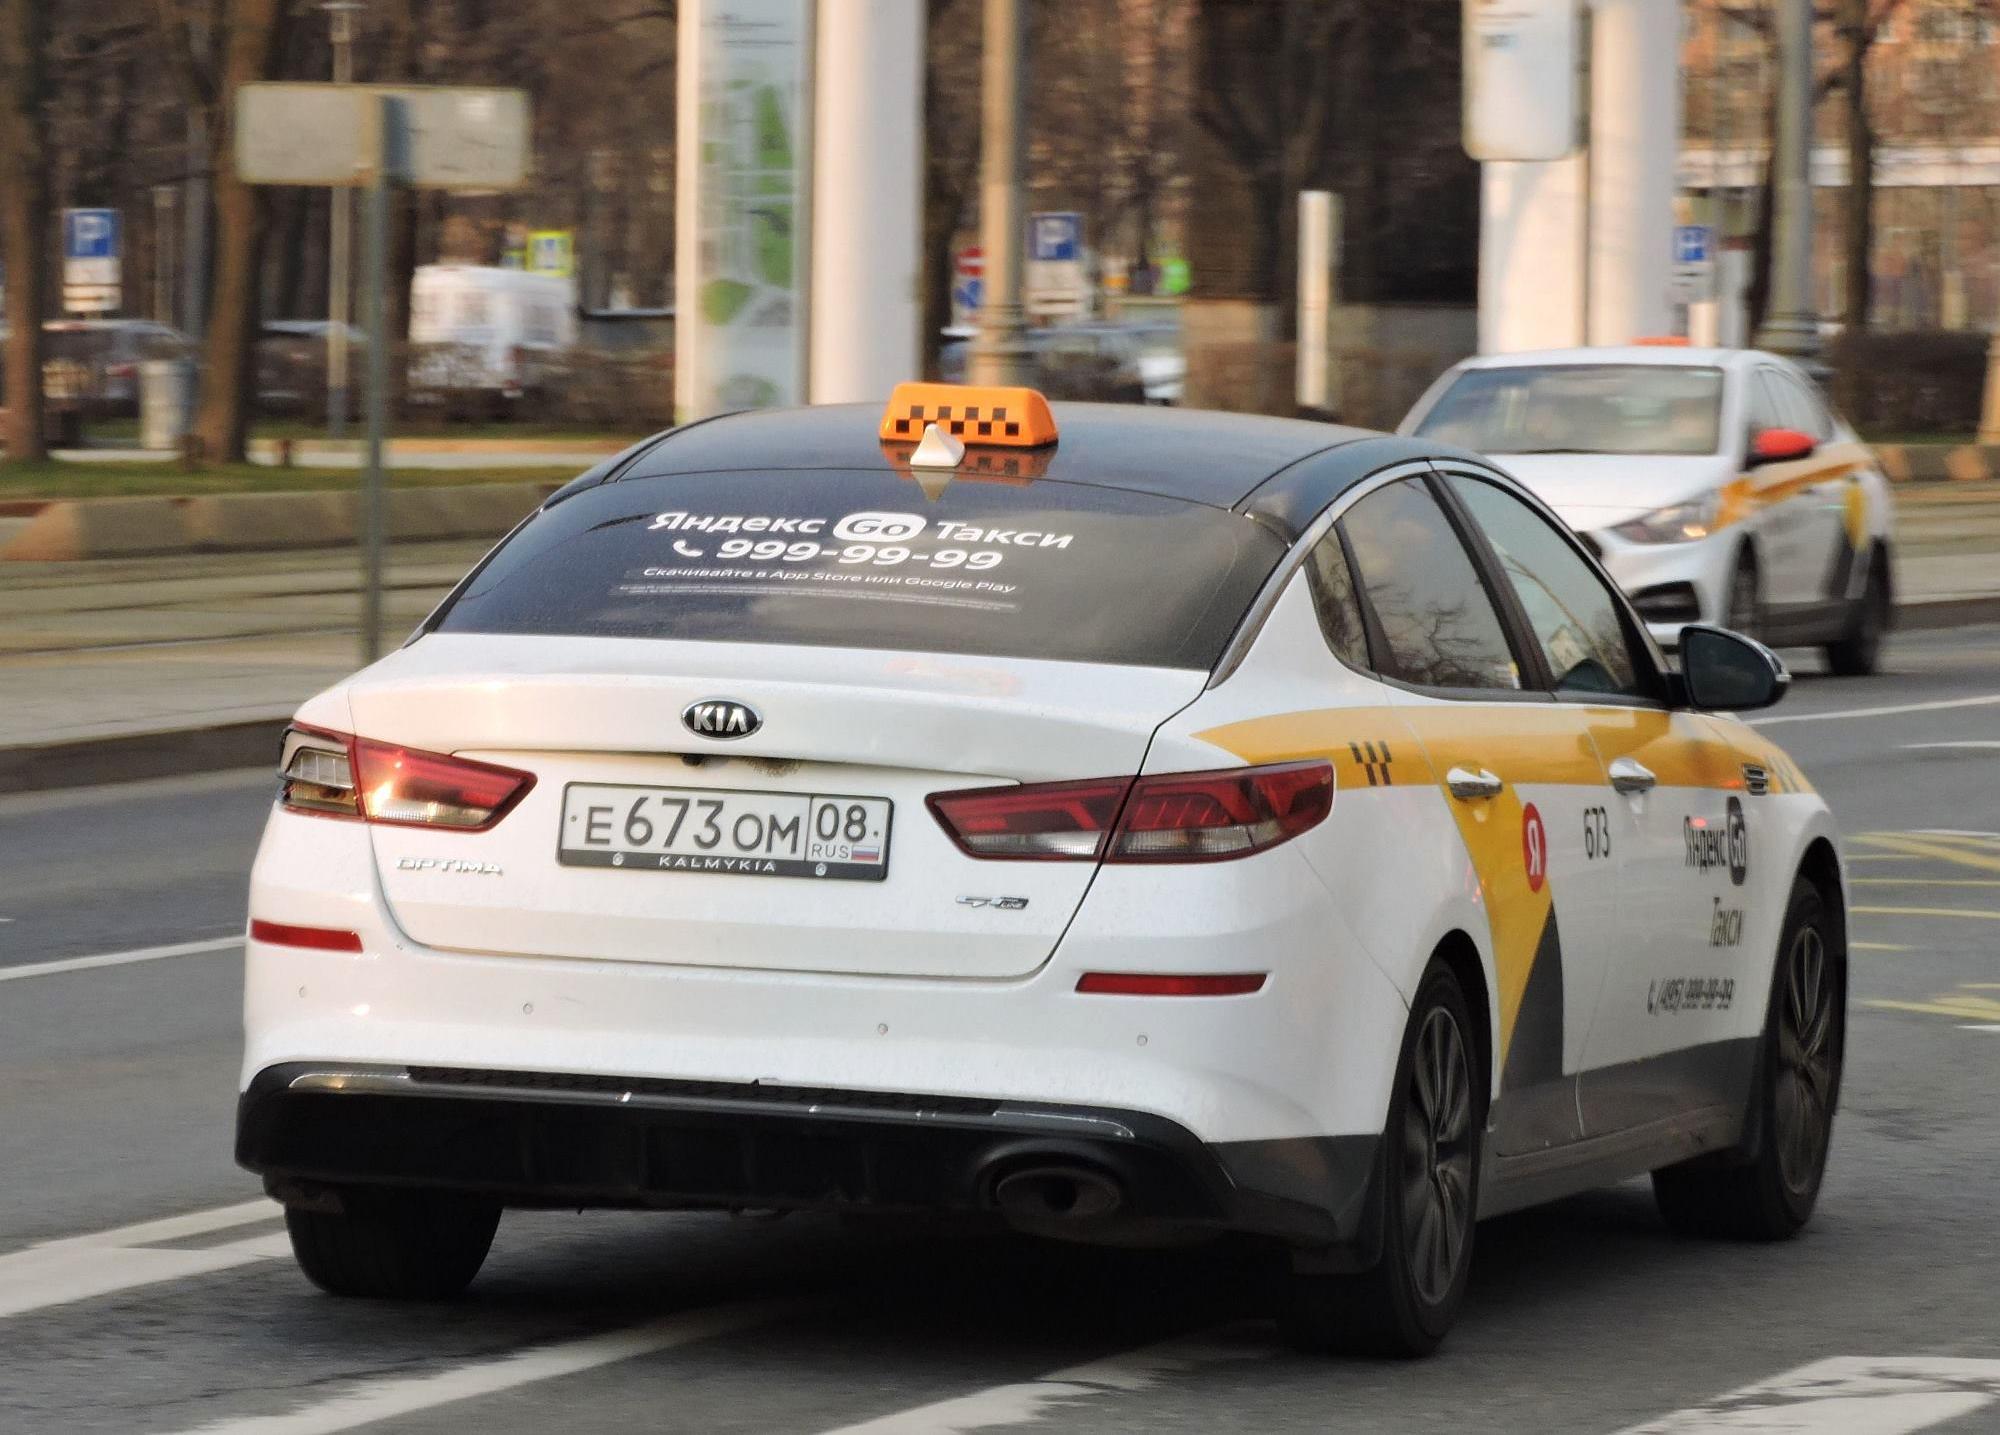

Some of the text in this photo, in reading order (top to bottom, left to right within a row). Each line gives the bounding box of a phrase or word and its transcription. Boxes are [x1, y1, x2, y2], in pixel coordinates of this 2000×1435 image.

[647, 511, 827, 533] Яндекс
[936, 521, 1074, 549] Такси
[716, 538, 1003, 570] 999-99-99
[643, 567, 752, 578] Скачивайте
[769, 571, 809, 581] App
[812, 572, 862, 582] Store
[865, 575, 902, 584] или
[905, 577, 973, 590] Google
[975, 582, 1017, 594] Play
[693, 705, 747, 732] KIA
[816, 803, 867, 842] 08
[1584, 806, 1610, 860] 673
[811, 843, 848, 859] RUS
[1527, 818, 1541, 876] Я
[1684, 815, 1726, 873] Яндекс
[397, 858, 503, 875] OPTIMA
[659, 855, 777, 872] KALMYKIA
